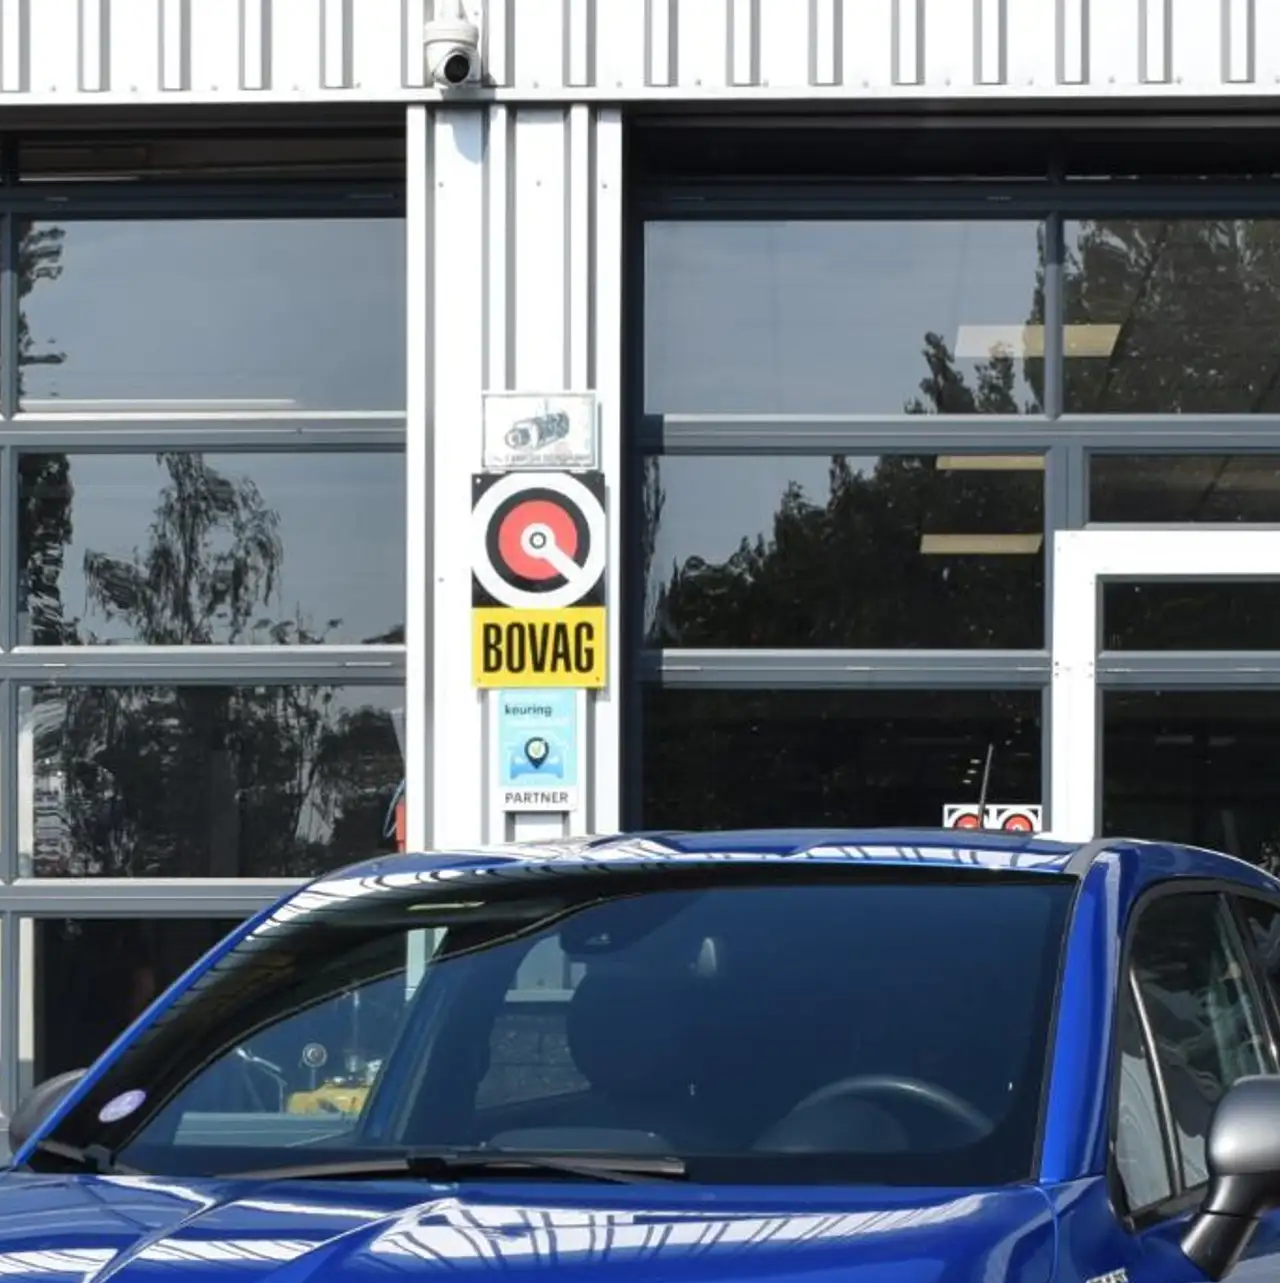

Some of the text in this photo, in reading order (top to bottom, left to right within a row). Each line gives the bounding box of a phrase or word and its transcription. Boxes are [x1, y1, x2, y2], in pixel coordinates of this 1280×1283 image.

[483, 622, 595, 673] BOVAG
[505, 704, 552, 717] keuring
[505, 791, 569, 804] PARTNER
